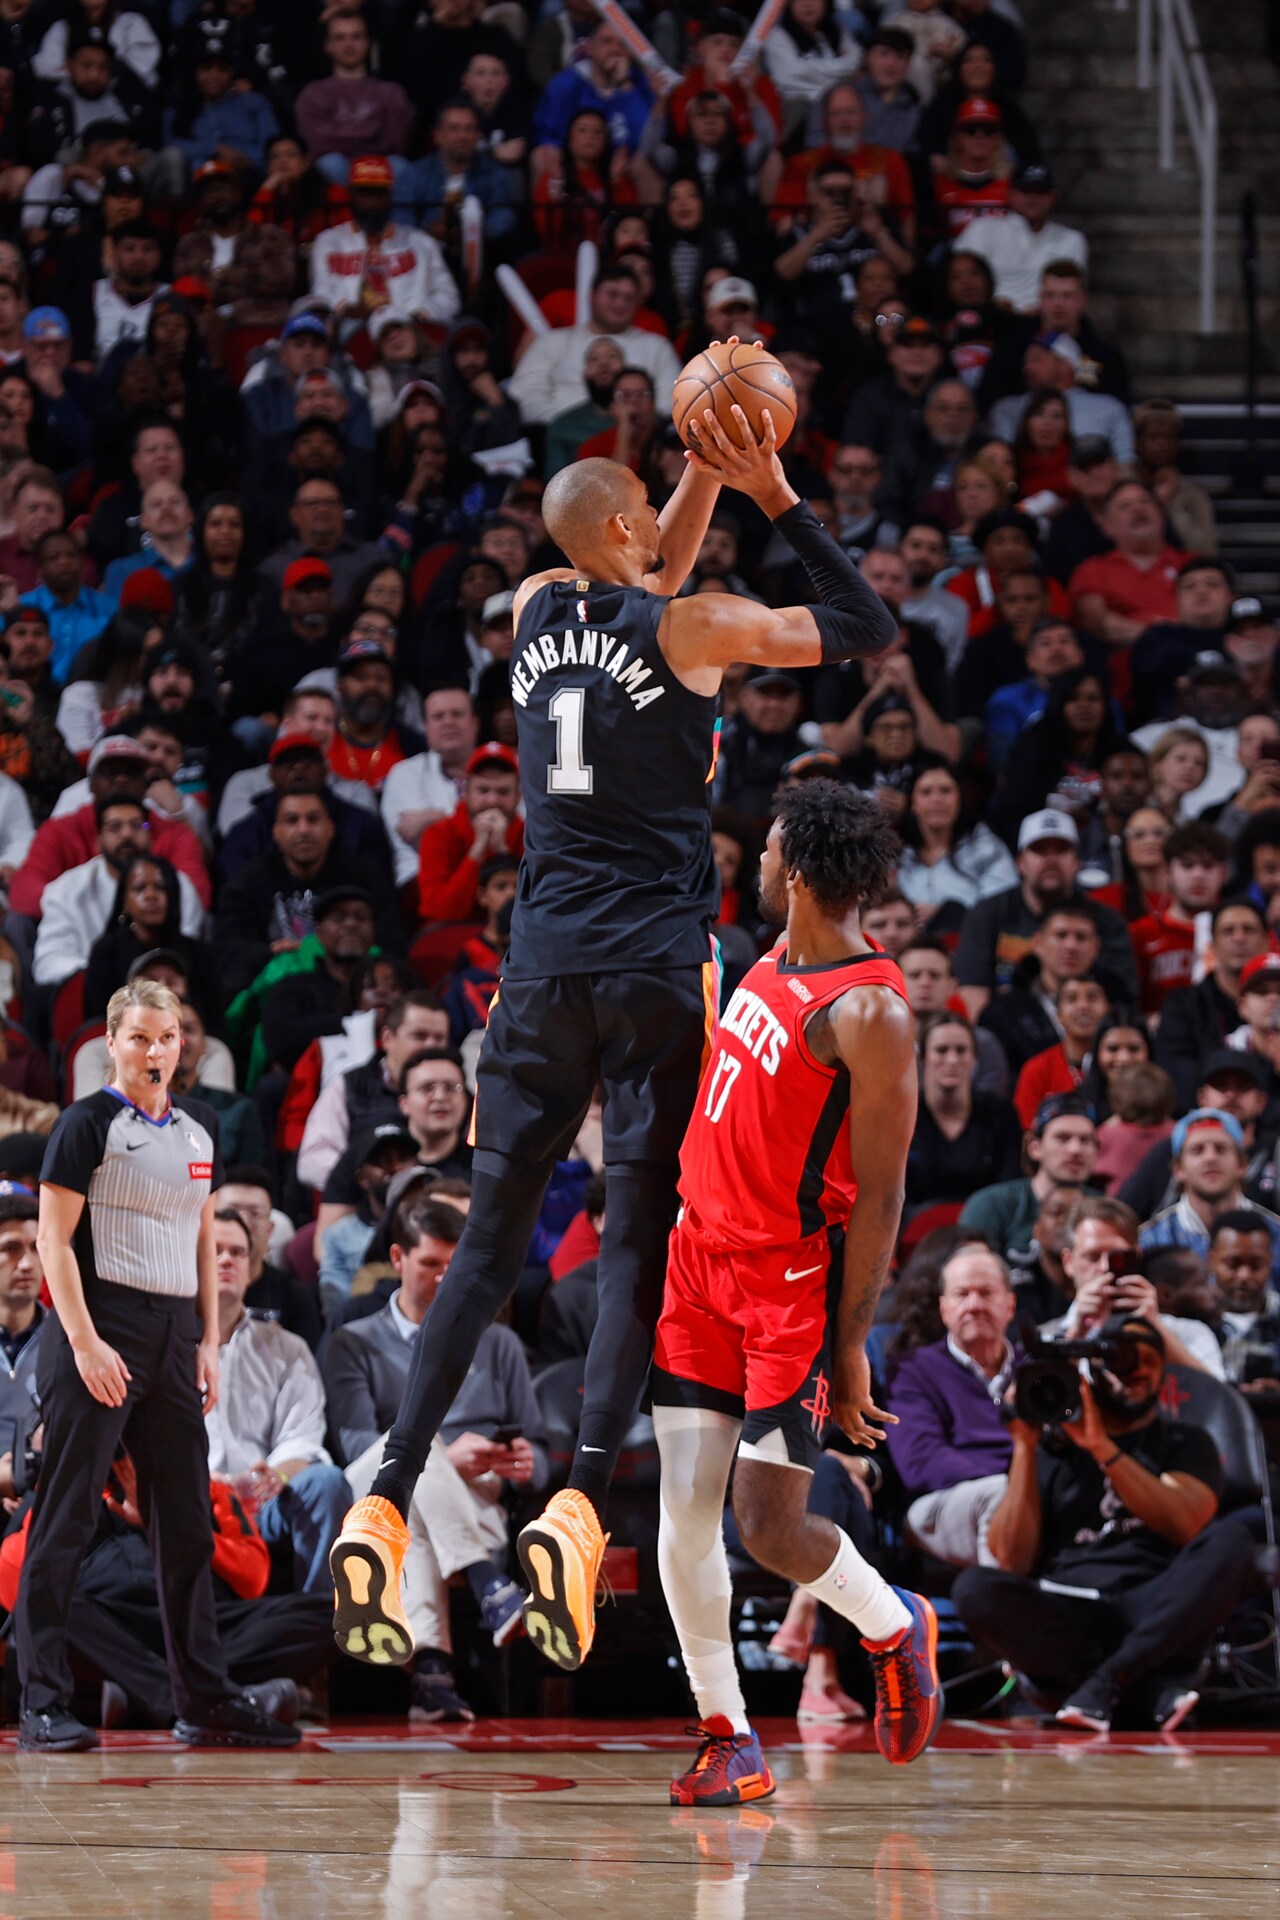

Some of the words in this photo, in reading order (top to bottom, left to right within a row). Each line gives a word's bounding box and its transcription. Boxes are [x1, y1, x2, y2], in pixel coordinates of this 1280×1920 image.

[511, 629, 666, 711] WEMBANYAMA
[547, 688, 593, 795] 1
[719, 987, 789, 1077] OCKETS
[704, 1049, 742, 1124] 17
